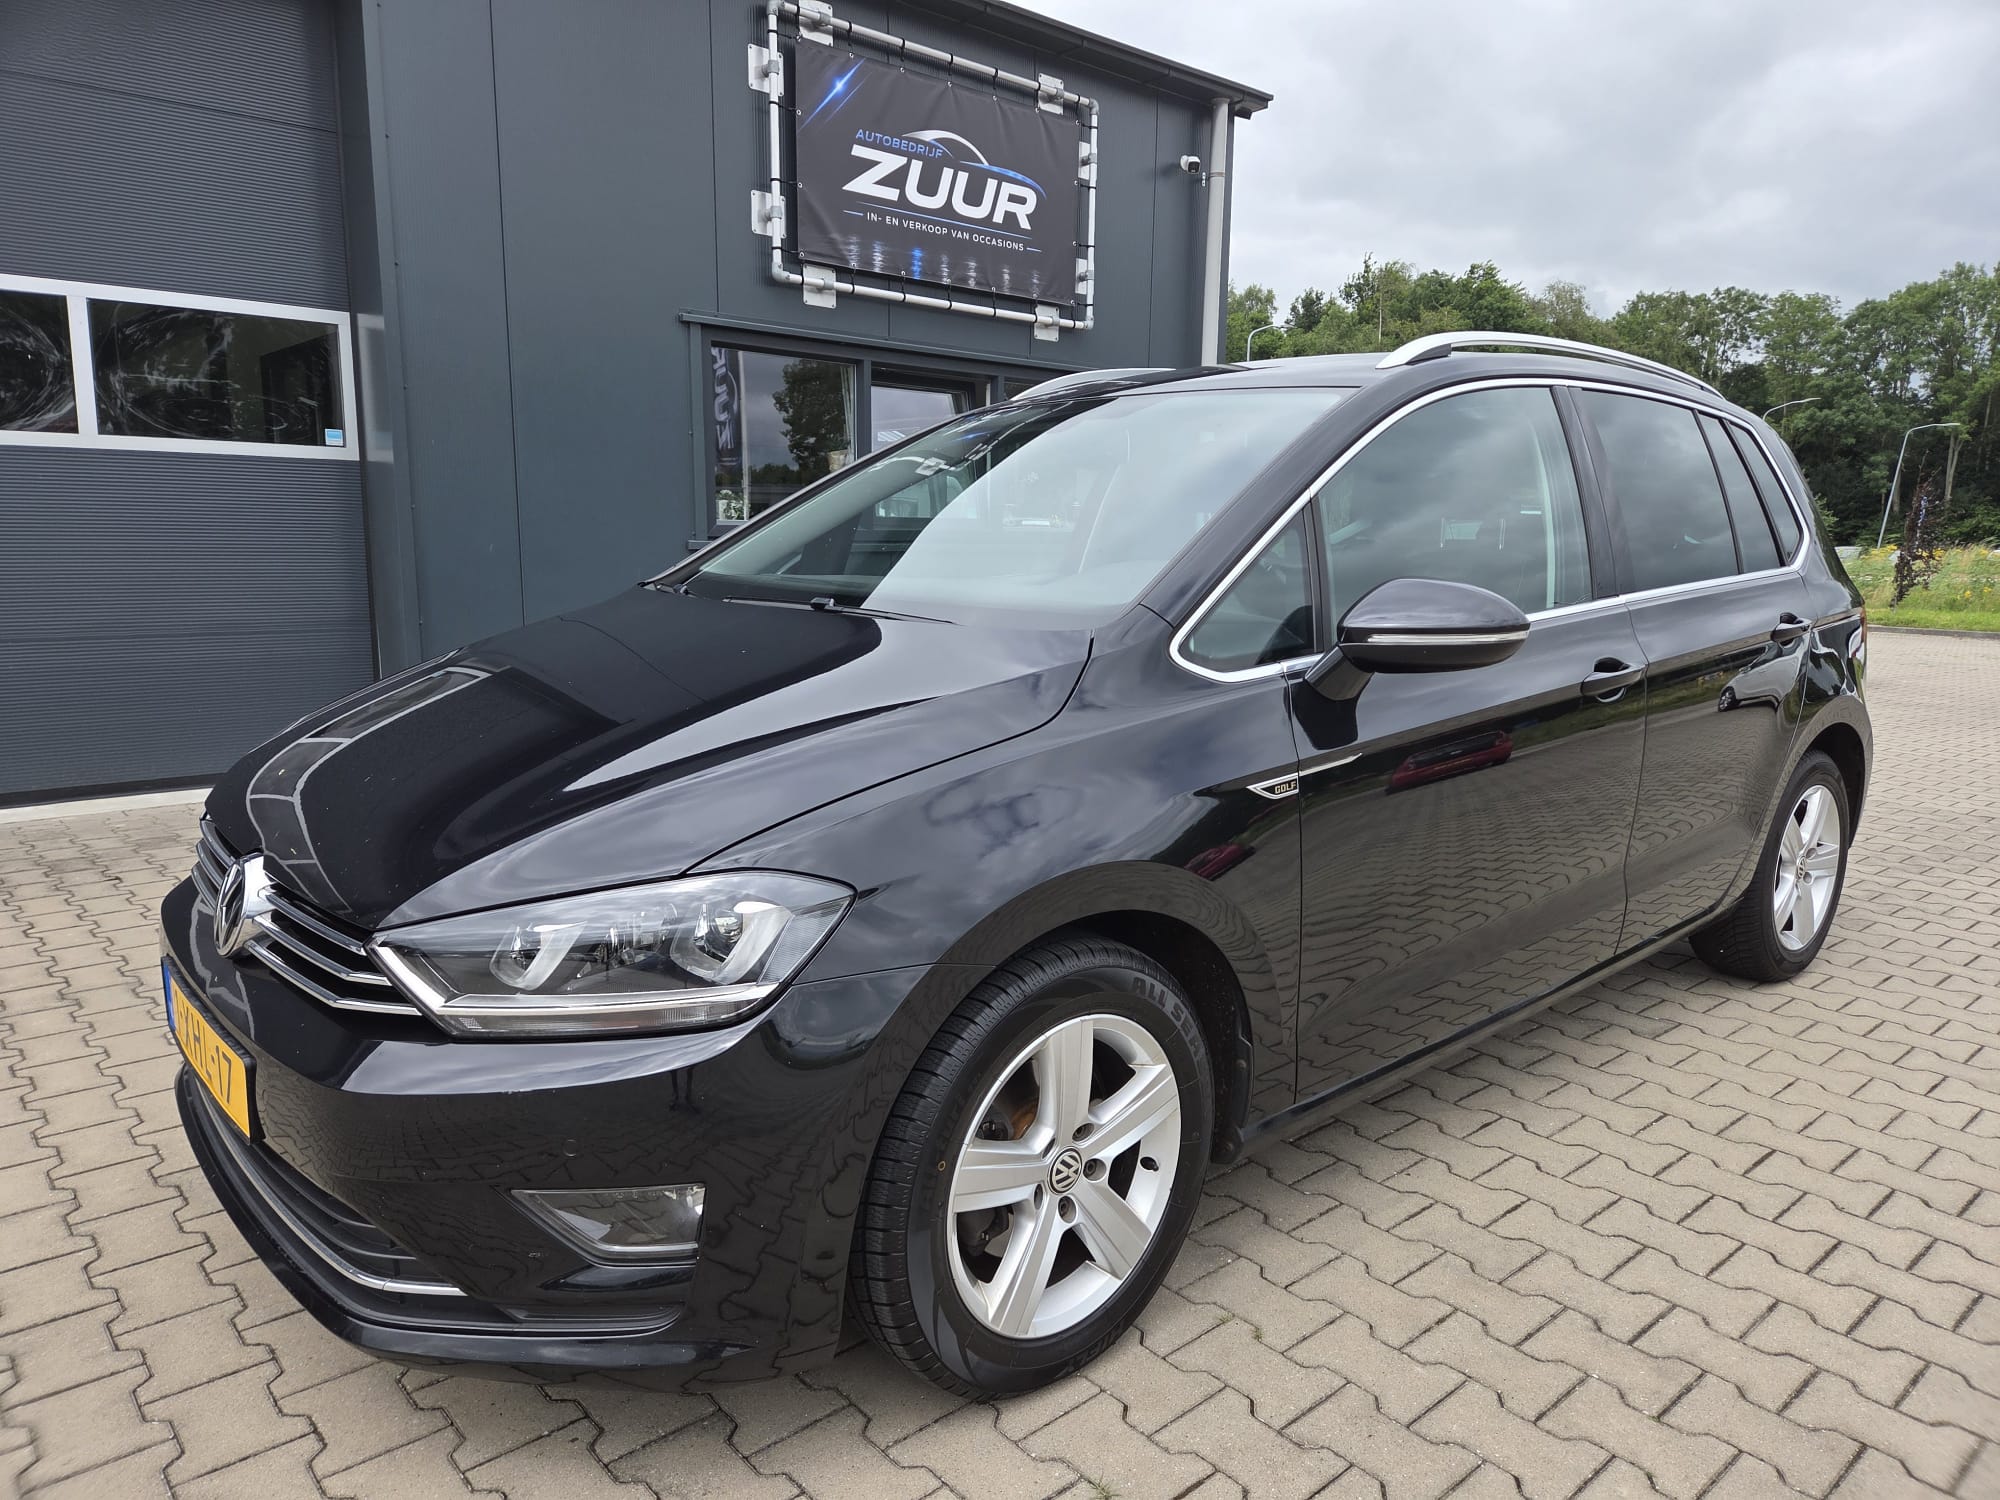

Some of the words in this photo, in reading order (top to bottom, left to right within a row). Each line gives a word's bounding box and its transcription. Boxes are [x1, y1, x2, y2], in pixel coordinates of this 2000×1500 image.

[855, 128, 943, 158] AUTOBEDRIJF
[842, 144, 1037, 230] ZUUR
[867, 211, 882, 222] IN-
[886, 215, 899, 226] EN
[902, 219, 948, 235] VERKOOP
[951, 229, 970, 241] VAN
[972, 233, 1025, 251] OCCASIONS
[1274, 781, 1297, 794] GOLF
